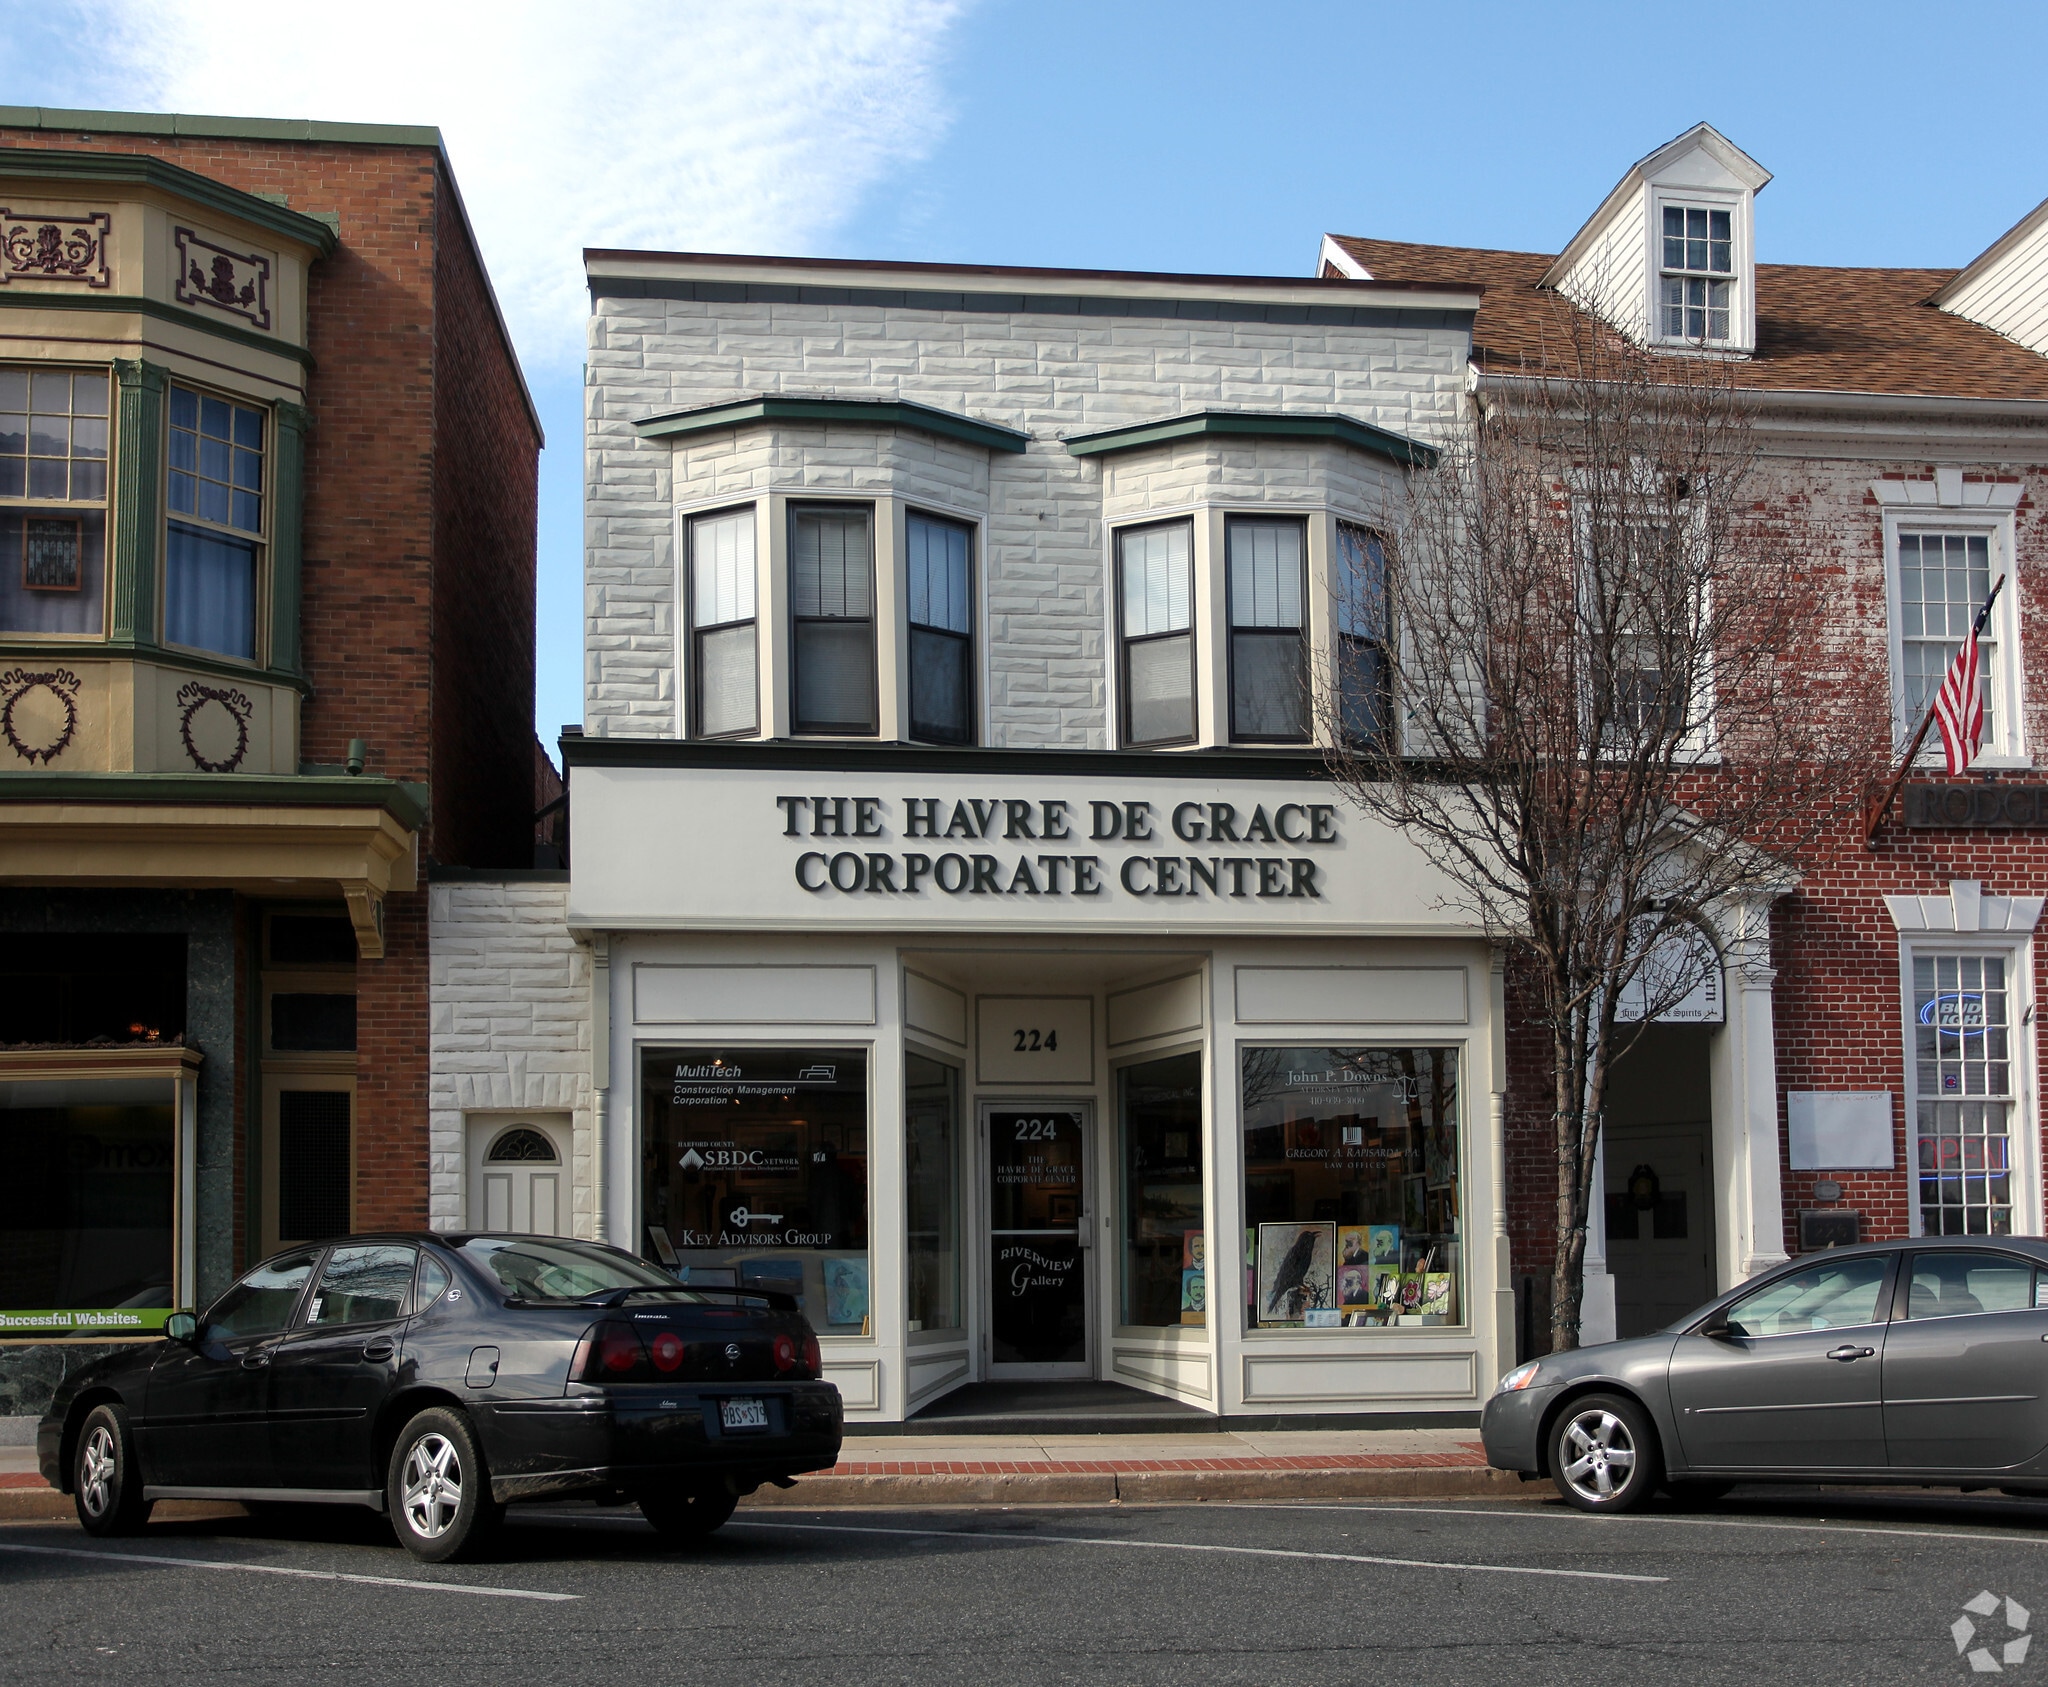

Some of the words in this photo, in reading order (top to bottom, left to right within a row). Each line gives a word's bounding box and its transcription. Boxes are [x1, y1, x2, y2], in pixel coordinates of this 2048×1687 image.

[776, 796, 883, 838] THE
[902, 797, 1070, 841] HAVRE
[1088, 800, 1153, 841] DE
[1171, 801, 1337, 843] GRACE
[795, 851, 1101, 895] CORPORATE
[1120, 855, 1321, 898] CENTER
[1620, 1008, 1639, 1019] Fine
[1673, 1008, 1702, 1018] Spirits
[1939, 1003, 1983, 1014] BUD
[1013, 1029, 1057, 1052] 224
[675, 1064, 742, 1078] MultiTech
[1285, 1070, 1319, 1087] John
[1326, 1070, 1337, 1083] P.
[1343, 1070, 1388, 1083] Downs
[674, 1085, 734, 1095] Construction
[737, 1085, 797, 1096] Management
[1300, 1086, 1341, 1094] ATTORNEY
[673, 1096, 728, 1106] Corporation
[1014, 1118, 1057, 1141] 224
[705, 1150, 764, 1166] SBDC
[764, 1157, 800, 1165] NETWORK
[1027, 1156, 1046, 1164] THE
[1285, 1148, 1330, 1158] GREGORY
[997, 1165, 1028, 1174] HAVRE
[1031, 1165, 1042, 1174] DE
[1045, 1165, 1076, 1174] GRACE
[997, 1175, 1043, 1184] CORPORATE
[1045, 1175, 1076, 1184] CENTER
[682, 1229, 712, 1245] KEY
[717, 1229, 782, 1245] ADVISORS
[784, 1229, 832, 1245] GROUP
[1000, 1246, 1075, 1272] RIVERVIEW
[1010, 1262, 1064, 1297] Gallery
[0, 1312, 72, 1326] Successful
[75, 1312, 142, 1325] Websites.
[723, 1407, 743, 1425] 9BS
[747, 1406, 766, 1424] S79
